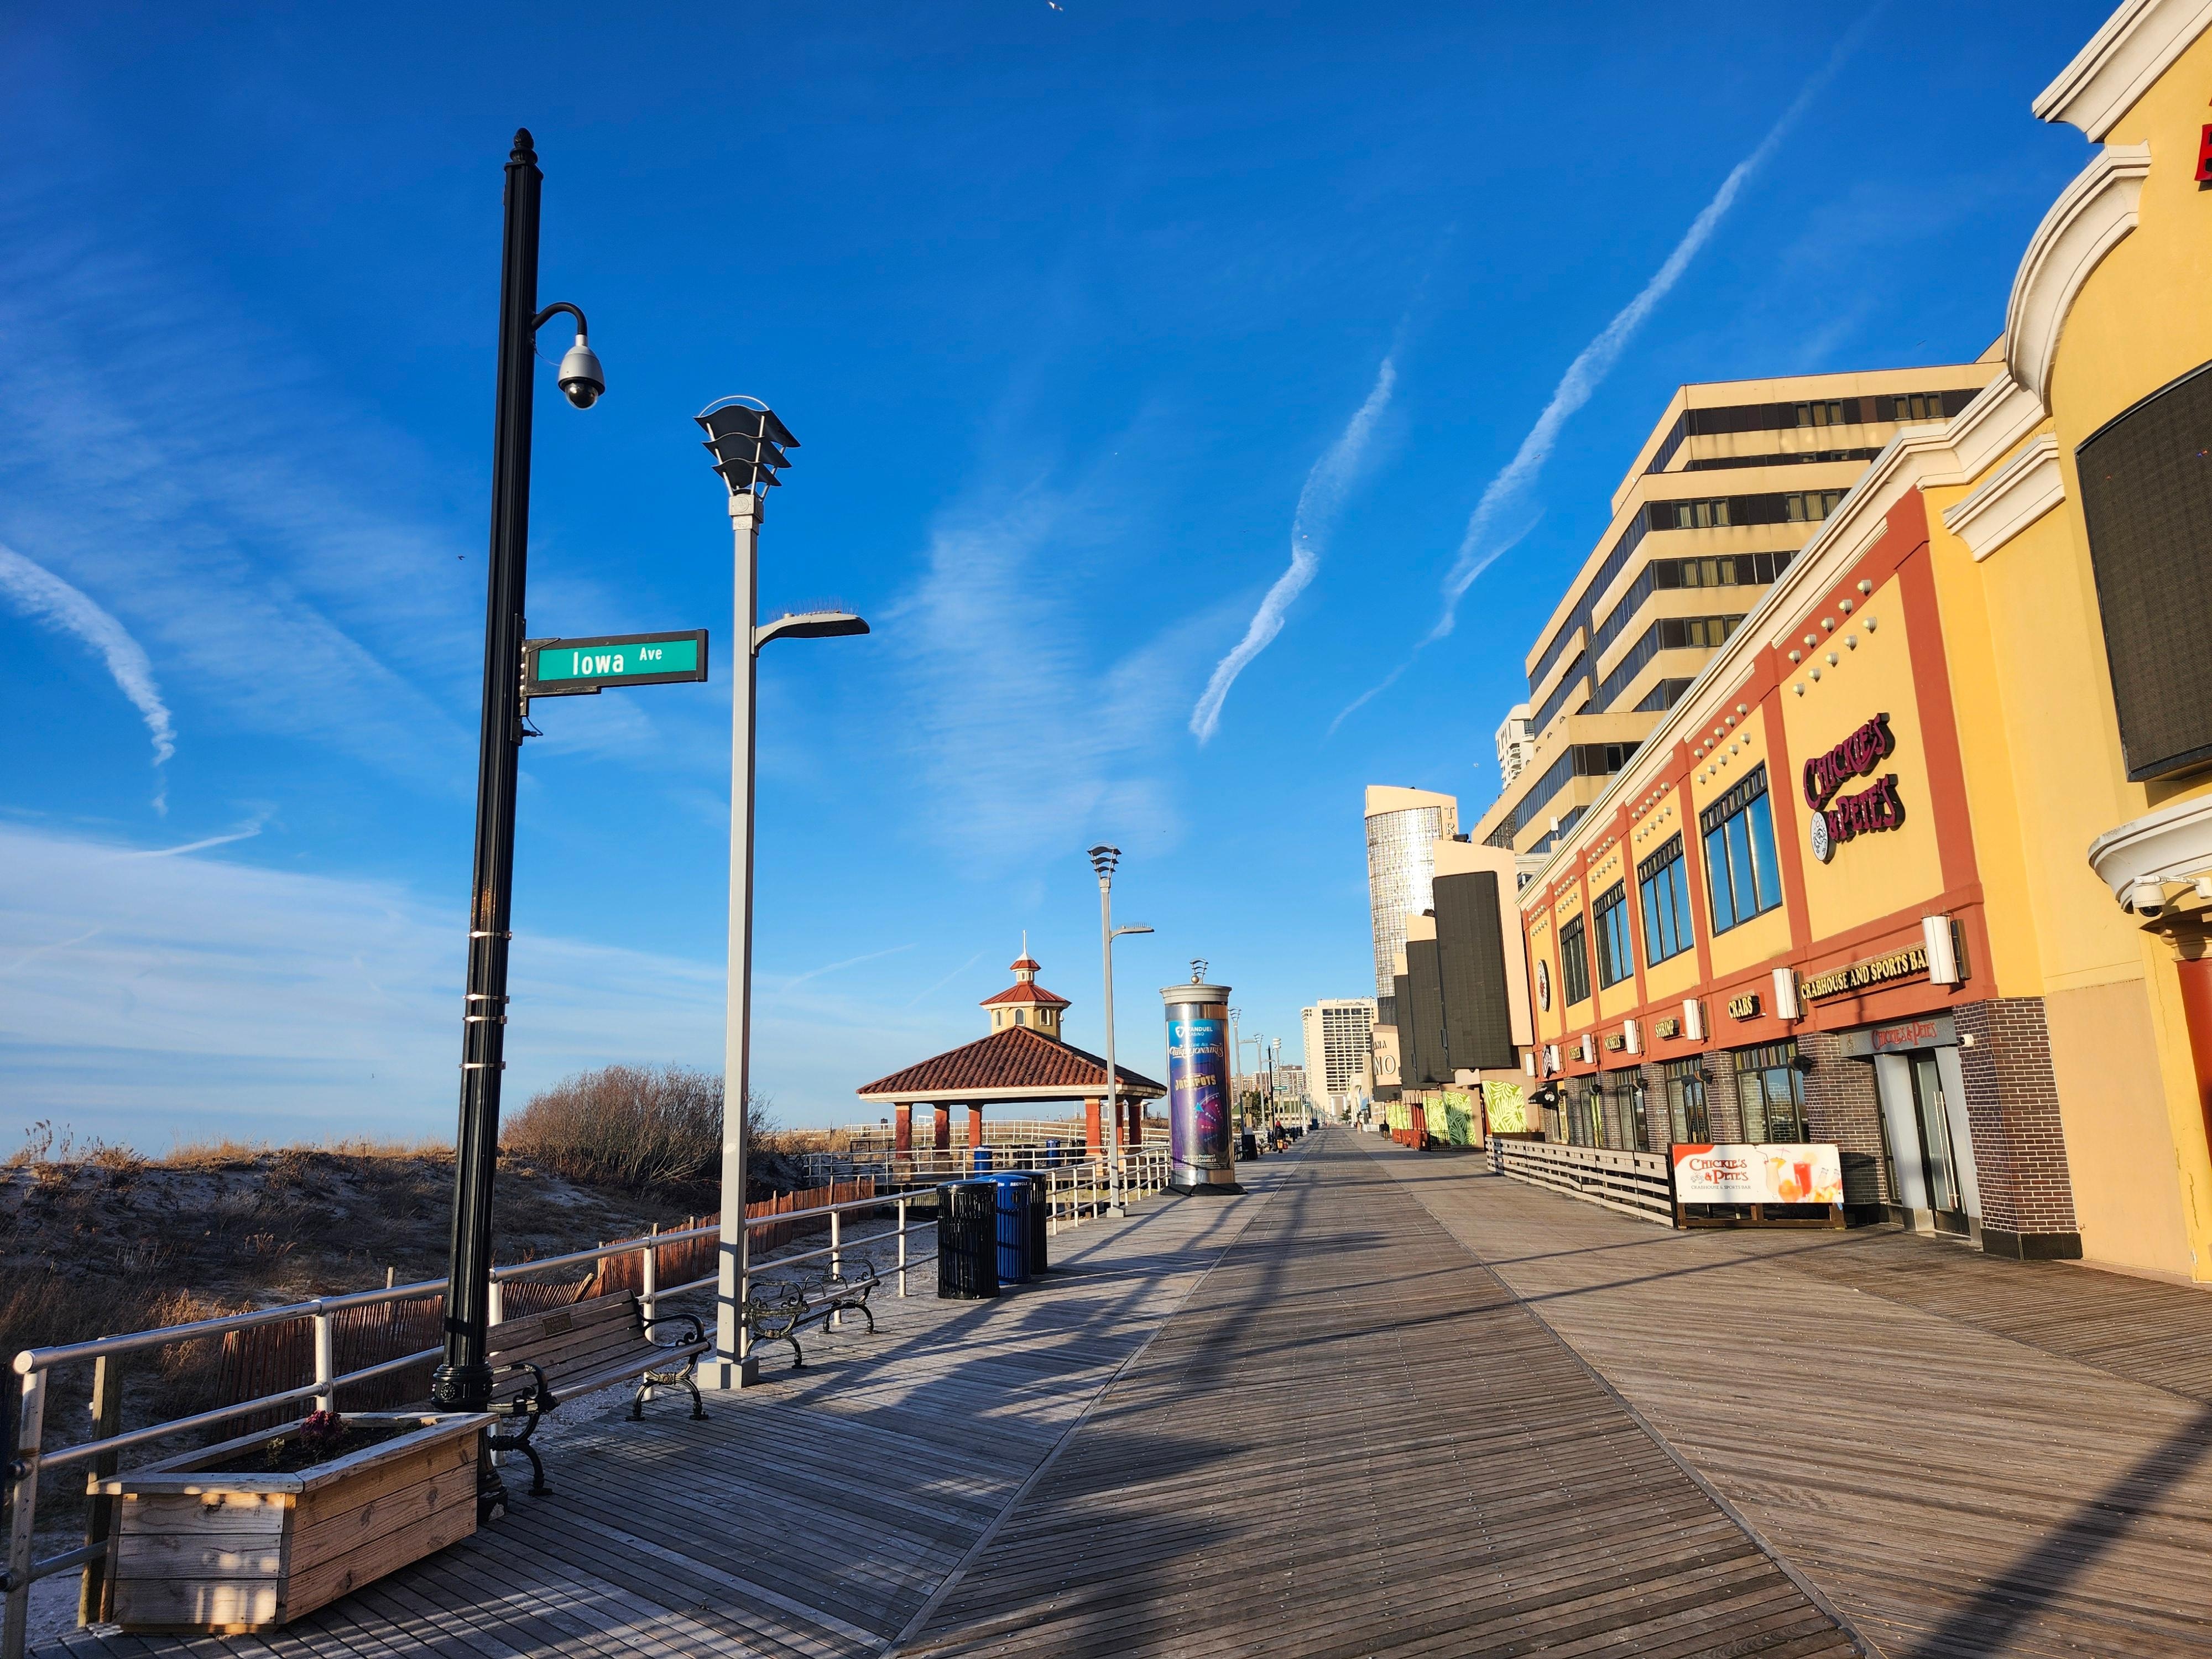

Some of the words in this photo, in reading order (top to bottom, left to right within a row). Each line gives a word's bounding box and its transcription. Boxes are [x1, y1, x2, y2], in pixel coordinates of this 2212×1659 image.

[573, 651, 624, 675] Iowa
[639, 647, 662, 661] Ave
[1803, 713, 1886, 809] CHICKIE'S
[1828, 810, 1839, 840] &
[1836, 774, 1897, 839] PETE'S
[1801, 971, 1848, 1000] CRABHOUSE
[1850, 965, 1870, 987] AND
[1871, 953, 1908, 981] SPORTS
[1728, 995, 1753, 1019] CRABS
[1655, 1020, 1674, 1038] SHRIMP
[1604, 1035, 1621, 1051] MUSSELS
[1689, 1159, 1747, 1171] CHICKIE'S
[1704, 1172, 1712, 1181] &
[1712, 1170, 1749, 1184] PETE'S
